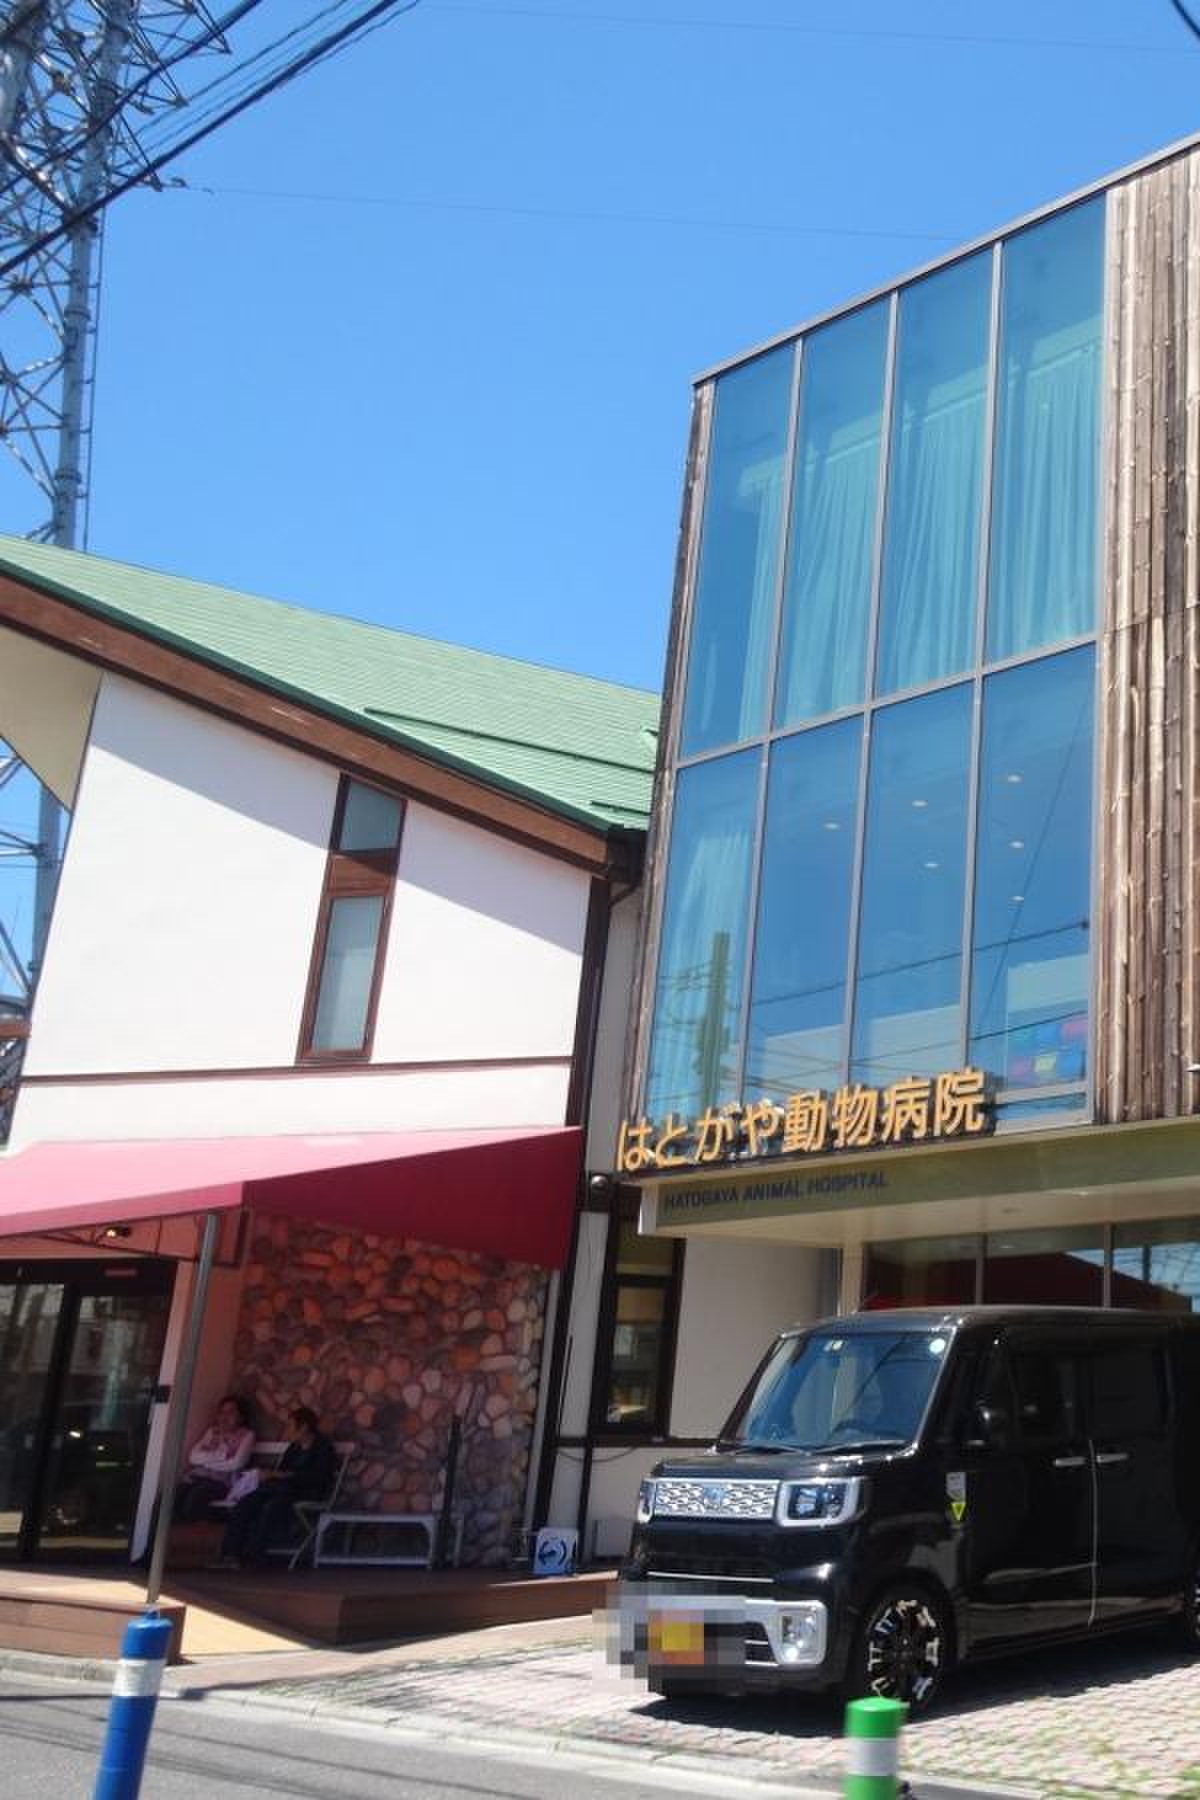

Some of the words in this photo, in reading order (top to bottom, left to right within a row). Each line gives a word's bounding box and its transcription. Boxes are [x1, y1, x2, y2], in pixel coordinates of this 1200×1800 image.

[617, 1067, 985, 1171] はとがや動物病院
[665, 1186, 738, 1210] HATOGAYA
[744, 1180, 801, 1201] ANIMAL
[807, 1171, 887, 1194] HOSPITAL
